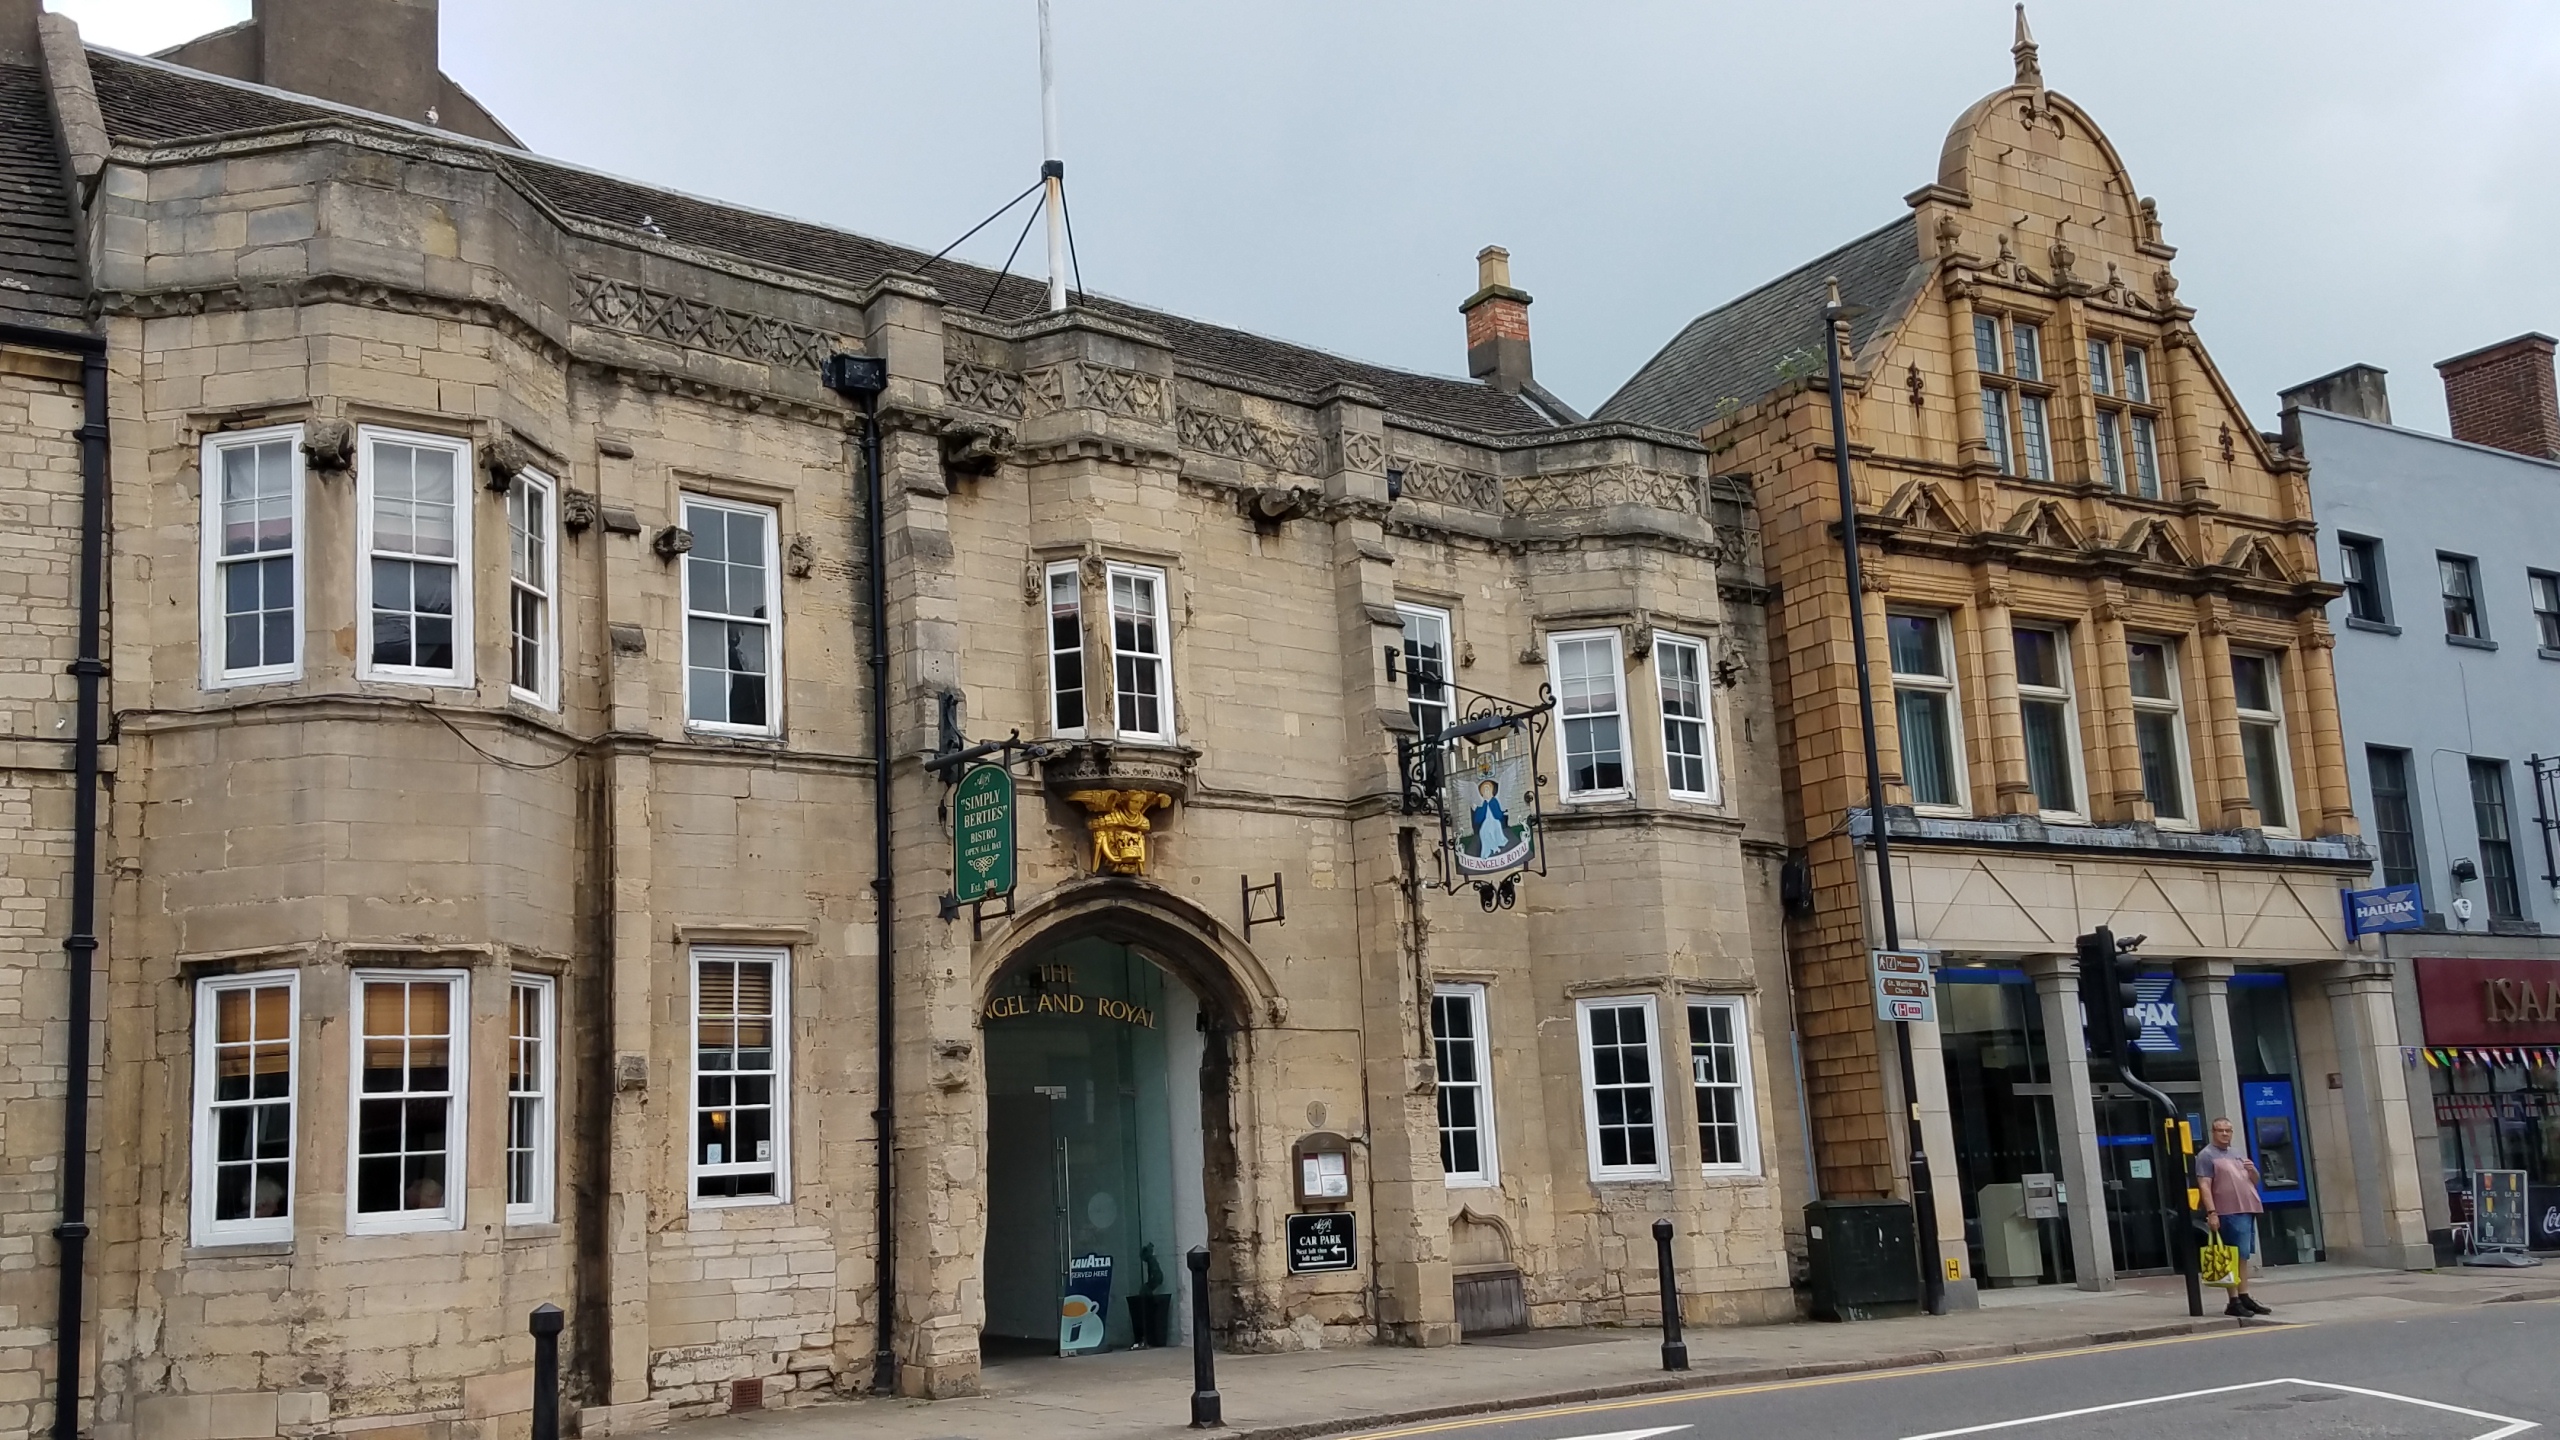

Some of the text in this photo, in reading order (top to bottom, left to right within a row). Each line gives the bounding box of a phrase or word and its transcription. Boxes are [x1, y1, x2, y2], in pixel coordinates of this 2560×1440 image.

[970, 828, 997, 844] BISTRO
[964, 841, 1002, 857] OPEN ALL DAY
[1460, 842, 1528, 869] THE ANGEL & ROYAL
[2356, 900, 2416, 918] HALIFAX
[1038, 964, 1078, 983] THE
[986, 993, 1158, 1030] GEL AND ROYAL
[1299, 1234, 1341, 1246] CAR PARK
[1071, 1254, 1111, 1269] LAVAZZA
[1071, 1270, 1109, 1279] SERVED HERE
